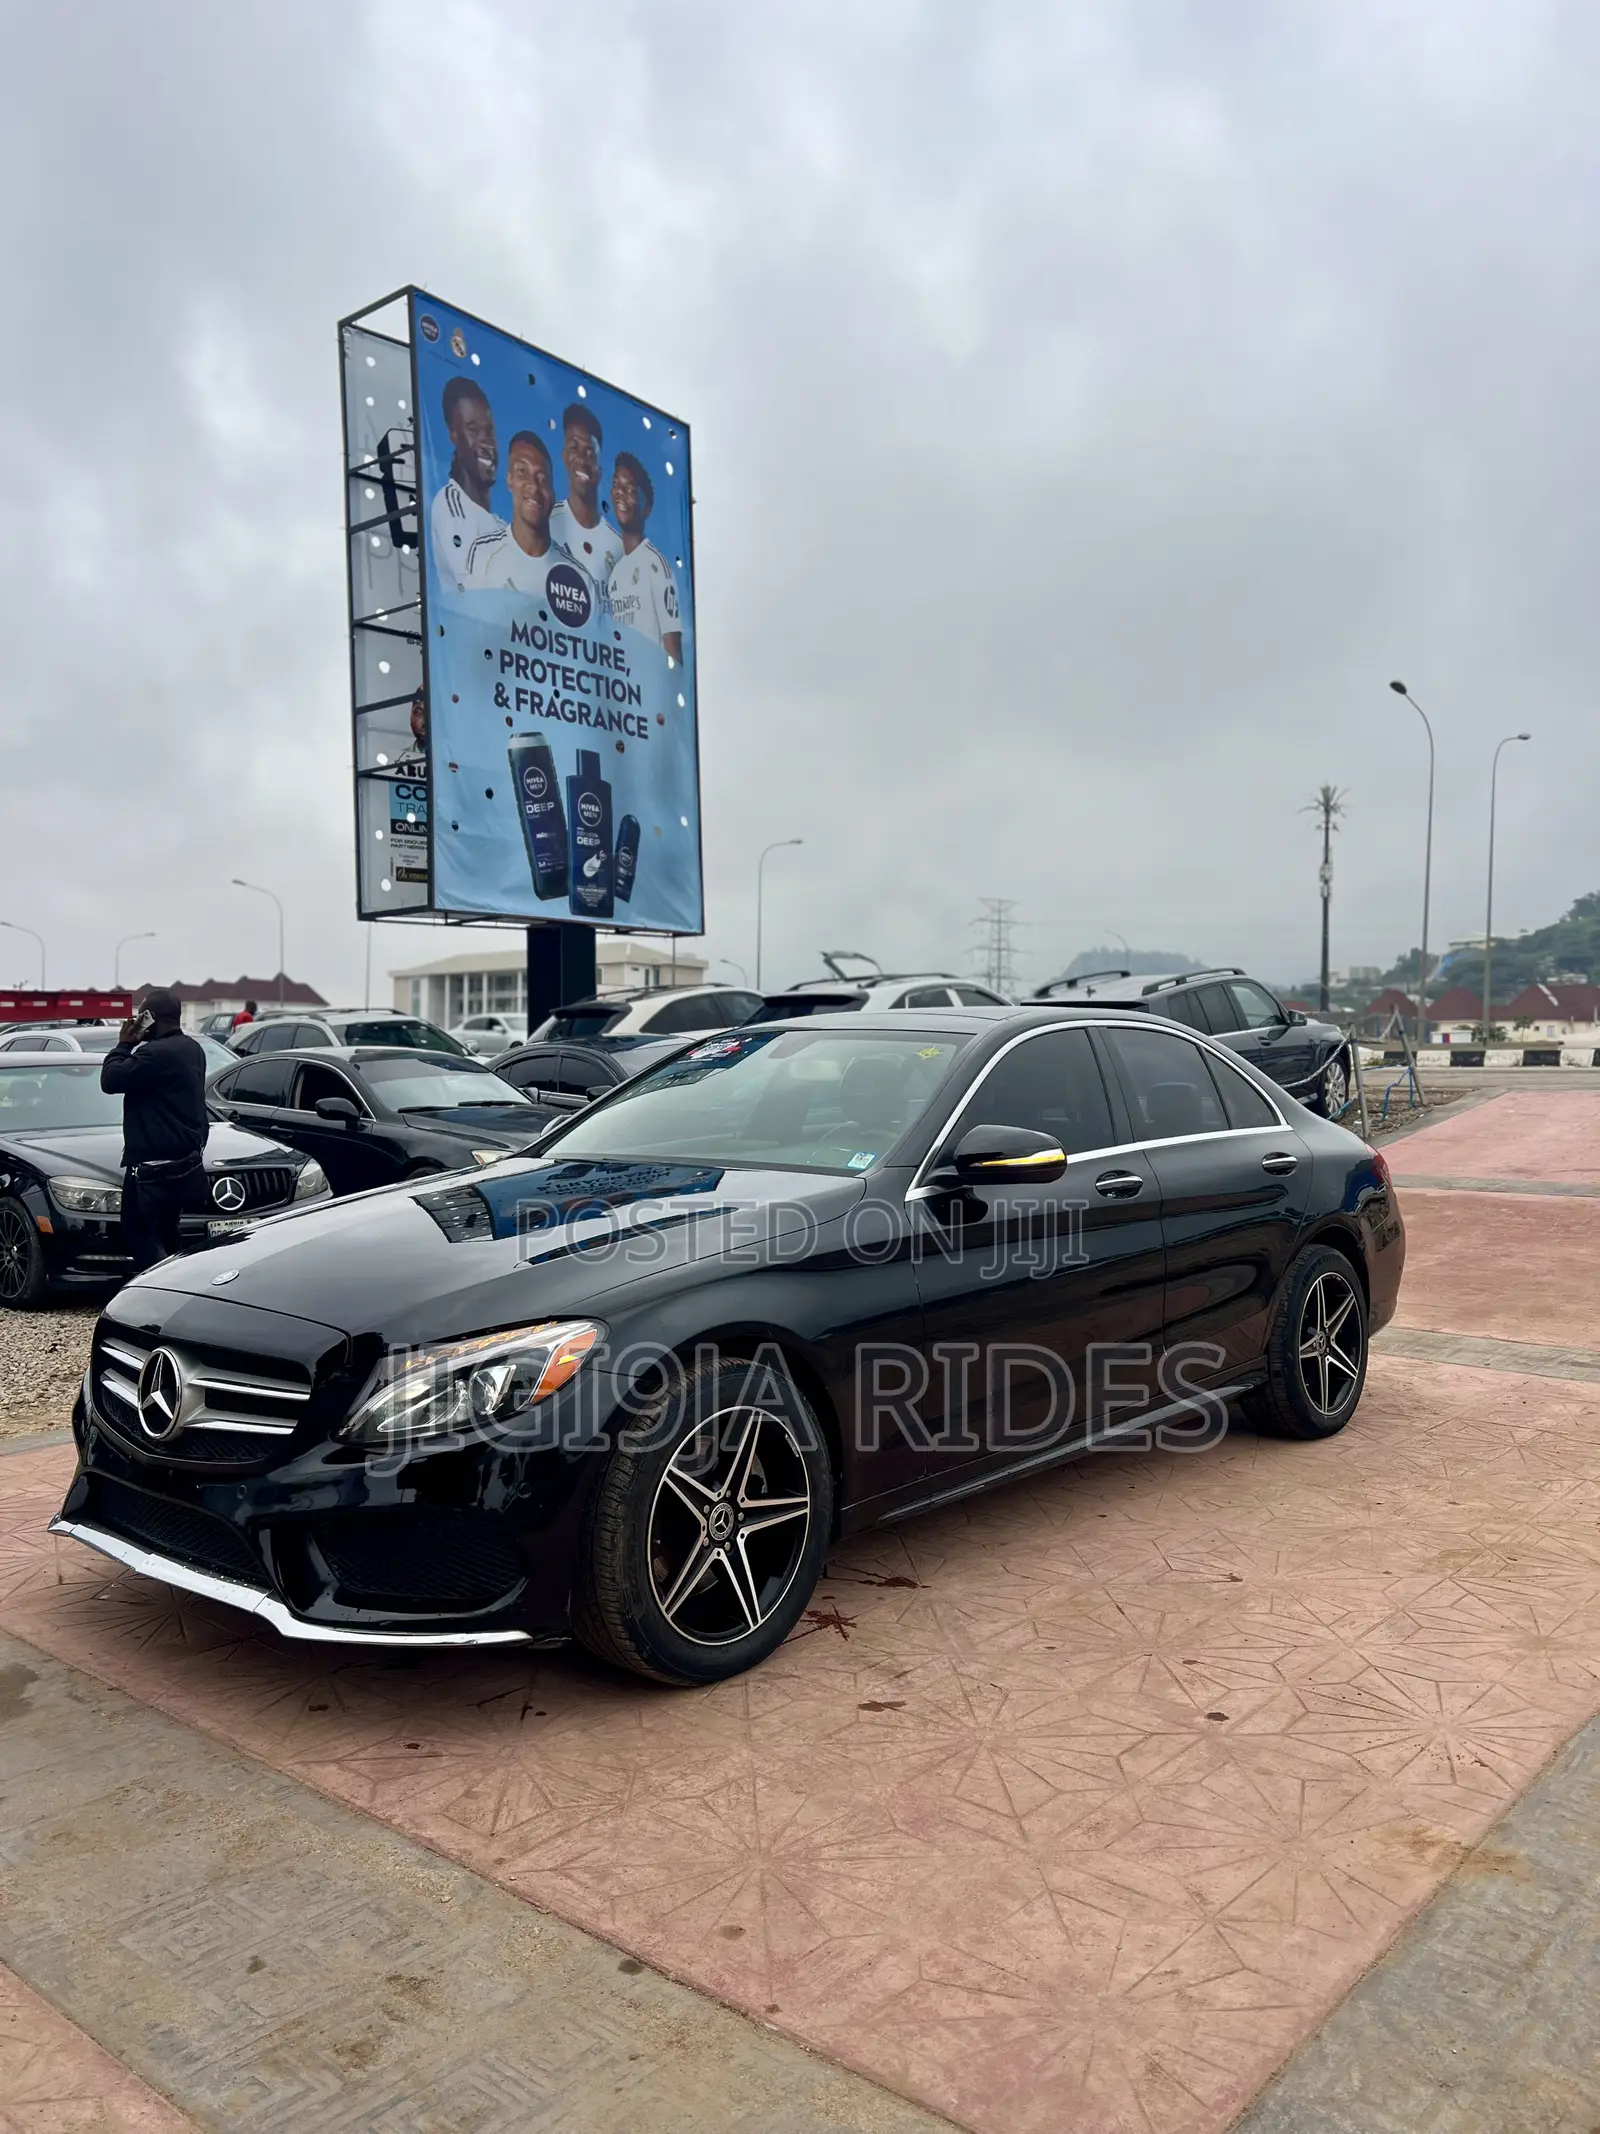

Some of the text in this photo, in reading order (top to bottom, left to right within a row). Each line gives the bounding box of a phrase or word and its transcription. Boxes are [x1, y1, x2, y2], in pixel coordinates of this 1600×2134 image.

[550, 581, 588, 604] NIVEA
[555, 596, 583, 615] MEN
[510, 618, 631, 677] MOISTURE,
[500, 648, 642, 708] PROTECTION
[493, 681, 649, 740] & FRAGRANCE
[525, 801, 555, 814] DEEP
[580, 803, 600, 813] NIVEA
[576, 836, 601, 846] DEEP
